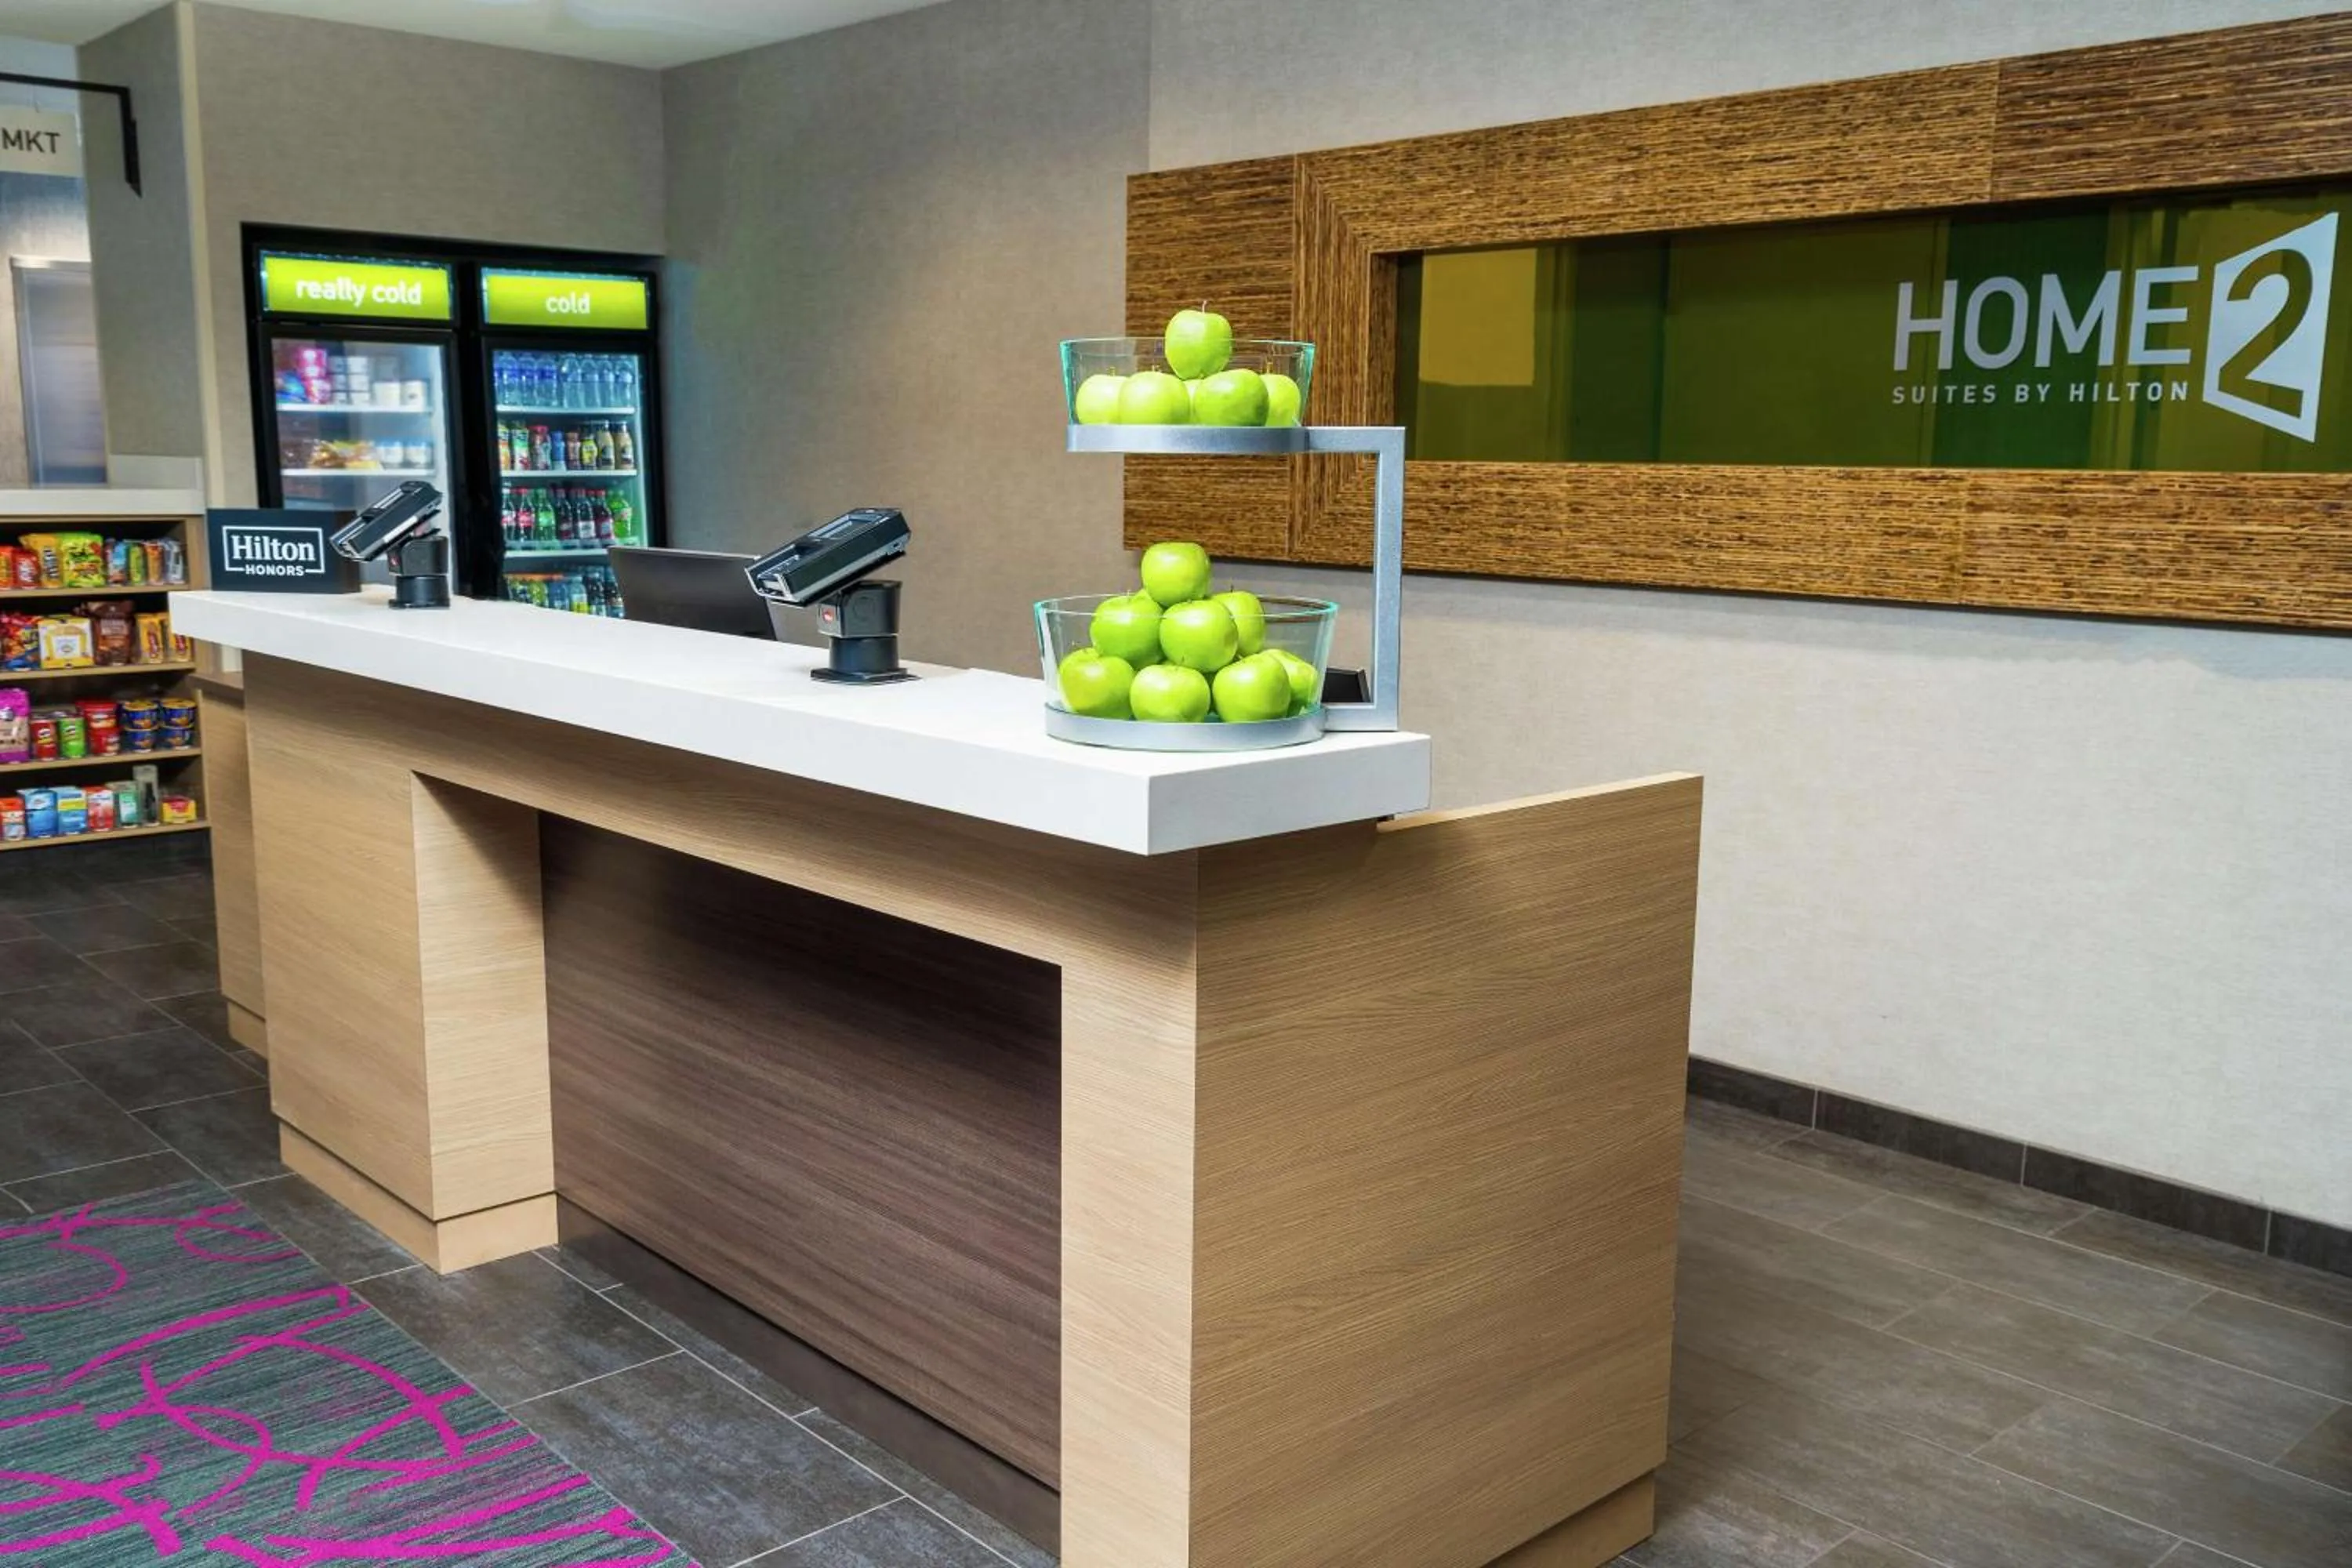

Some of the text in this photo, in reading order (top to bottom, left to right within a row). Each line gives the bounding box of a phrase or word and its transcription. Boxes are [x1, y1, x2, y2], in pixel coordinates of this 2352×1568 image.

[1, 127, 60, 154] MKT
[296, 277, 422, 307] really cold
[545, 293, 590, 314] cold
[1893, 264, 2199, 371] HOME
[1893, 381, 2188, 405] SUITES BY HILTON
[230, 534, 316, 562] Hilton
[245, 564, 305, 577] HONORS
